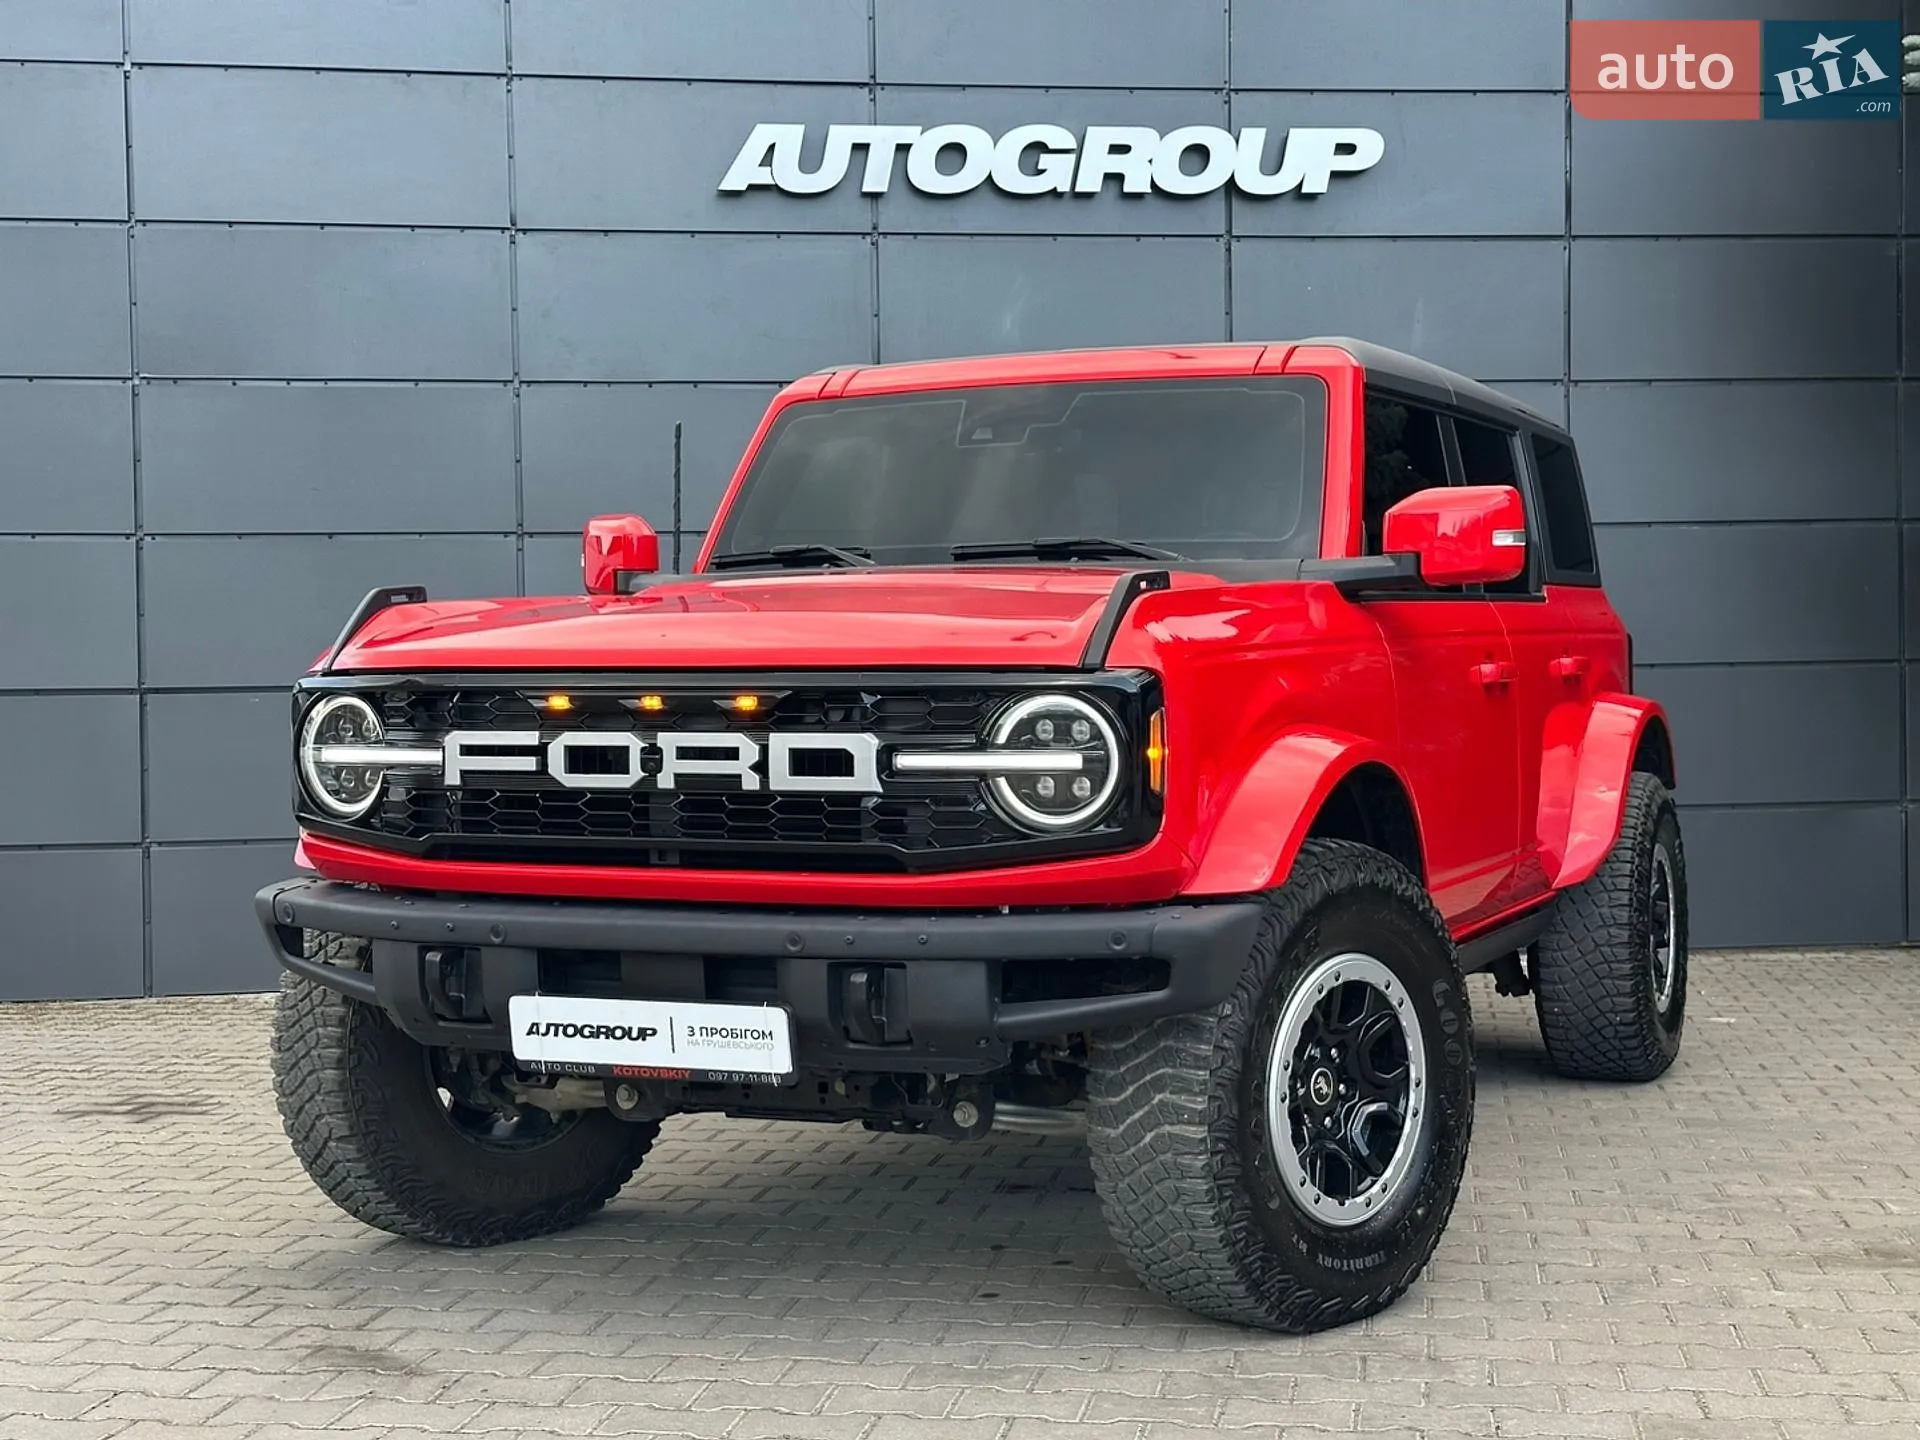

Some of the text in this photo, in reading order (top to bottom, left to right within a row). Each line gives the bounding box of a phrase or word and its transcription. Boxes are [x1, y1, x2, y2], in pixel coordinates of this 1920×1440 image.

[717, 123, 1385, 195] AUTOGROUP
[443, 730, 883, 793] FORD
[526, 1022, 657, 1041] AUTOGROUP
[699, 1026, 773, 1041] ПРОБІГОМ
[565, 1064, 596, 1074] CLUB
[612, 1065, 690, 1079] KOTOVSKIY
